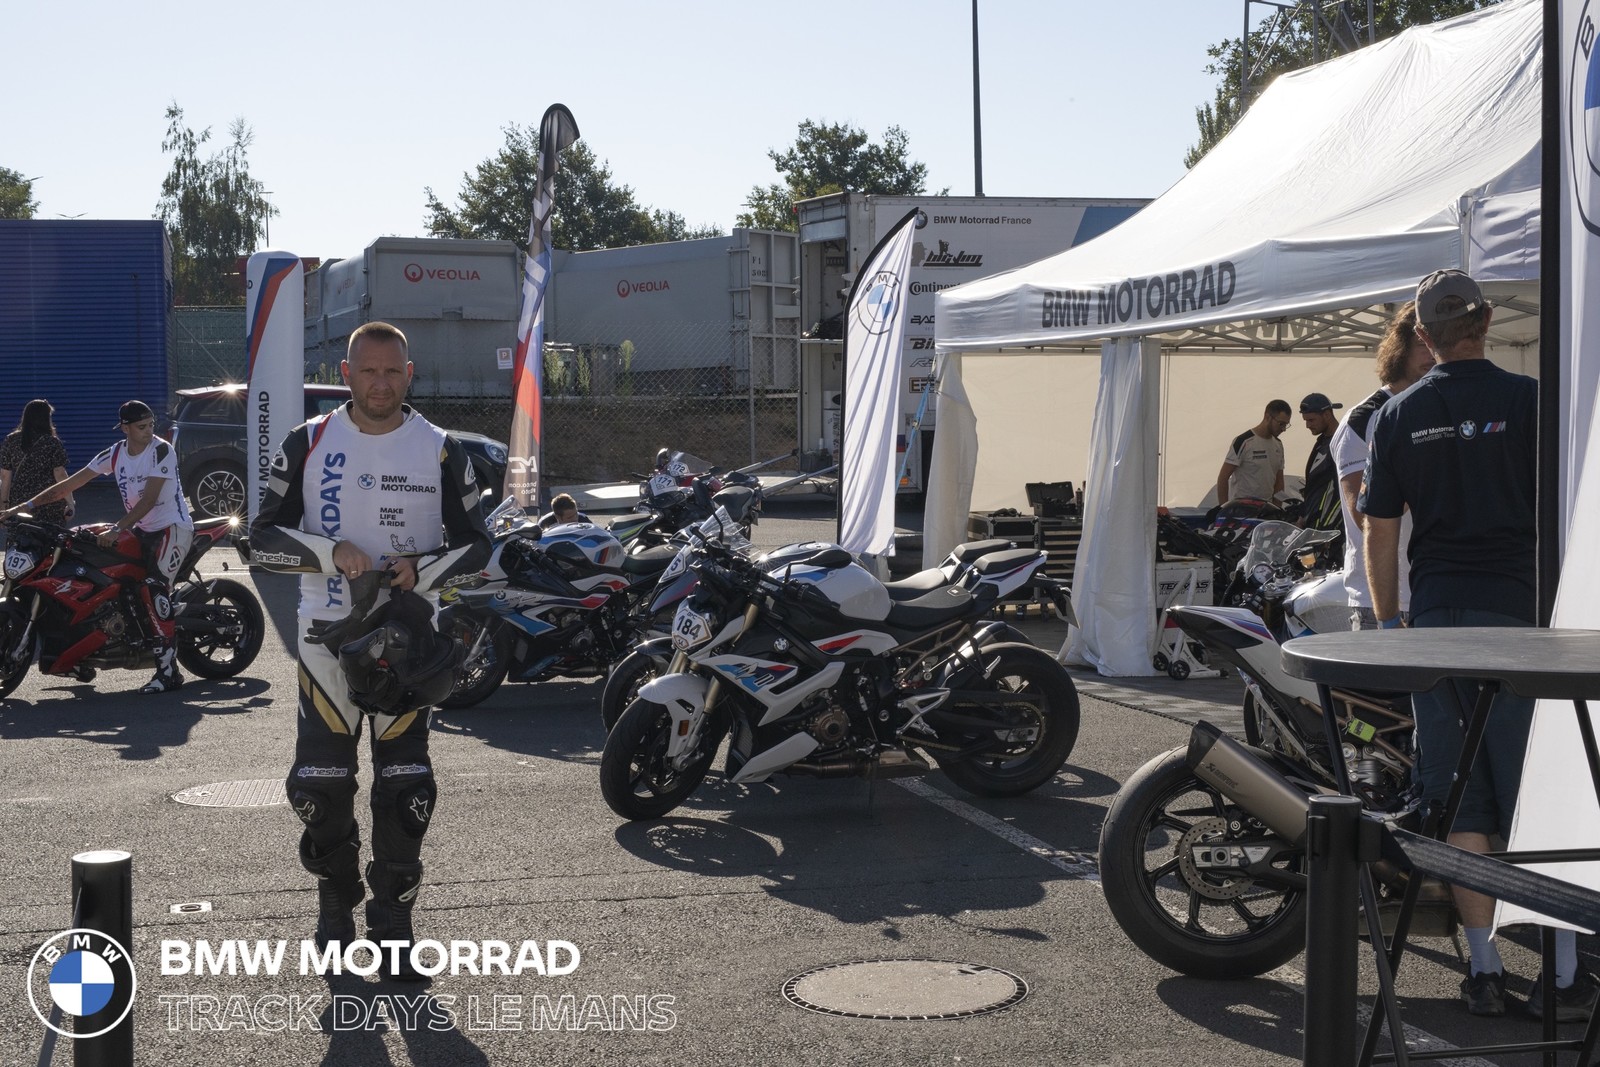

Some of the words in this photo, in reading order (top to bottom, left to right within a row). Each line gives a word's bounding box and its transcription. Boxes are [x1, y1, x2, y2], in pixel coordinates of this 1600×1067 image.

[933, 215, 957, 224] BMW
[959, 215, 1000, 224] Motorrad
[1001, 216, 1032, 225] France
[426, 269, 481, 281] VEOLIA
[632, 280, 670, 293] VEOLIA
[1042, 290, 1091, 328] BMW
[1097, 260, 1236, 325] MOTORRAD
[259, 391, 270, 481] MOTORRAD
[1411, 429, 1428, 439] BMW
[673, 464, 686, 473] 172
[381, 475, 408, 483] BMW
[658, 476, 672, 487] 171
[380, 484, 436, 494] MOTORRAD
[8, 556, 27, 569] 197
[676, 615, 701, 641] 184
[298, 766, 348, 778] alpinestars
